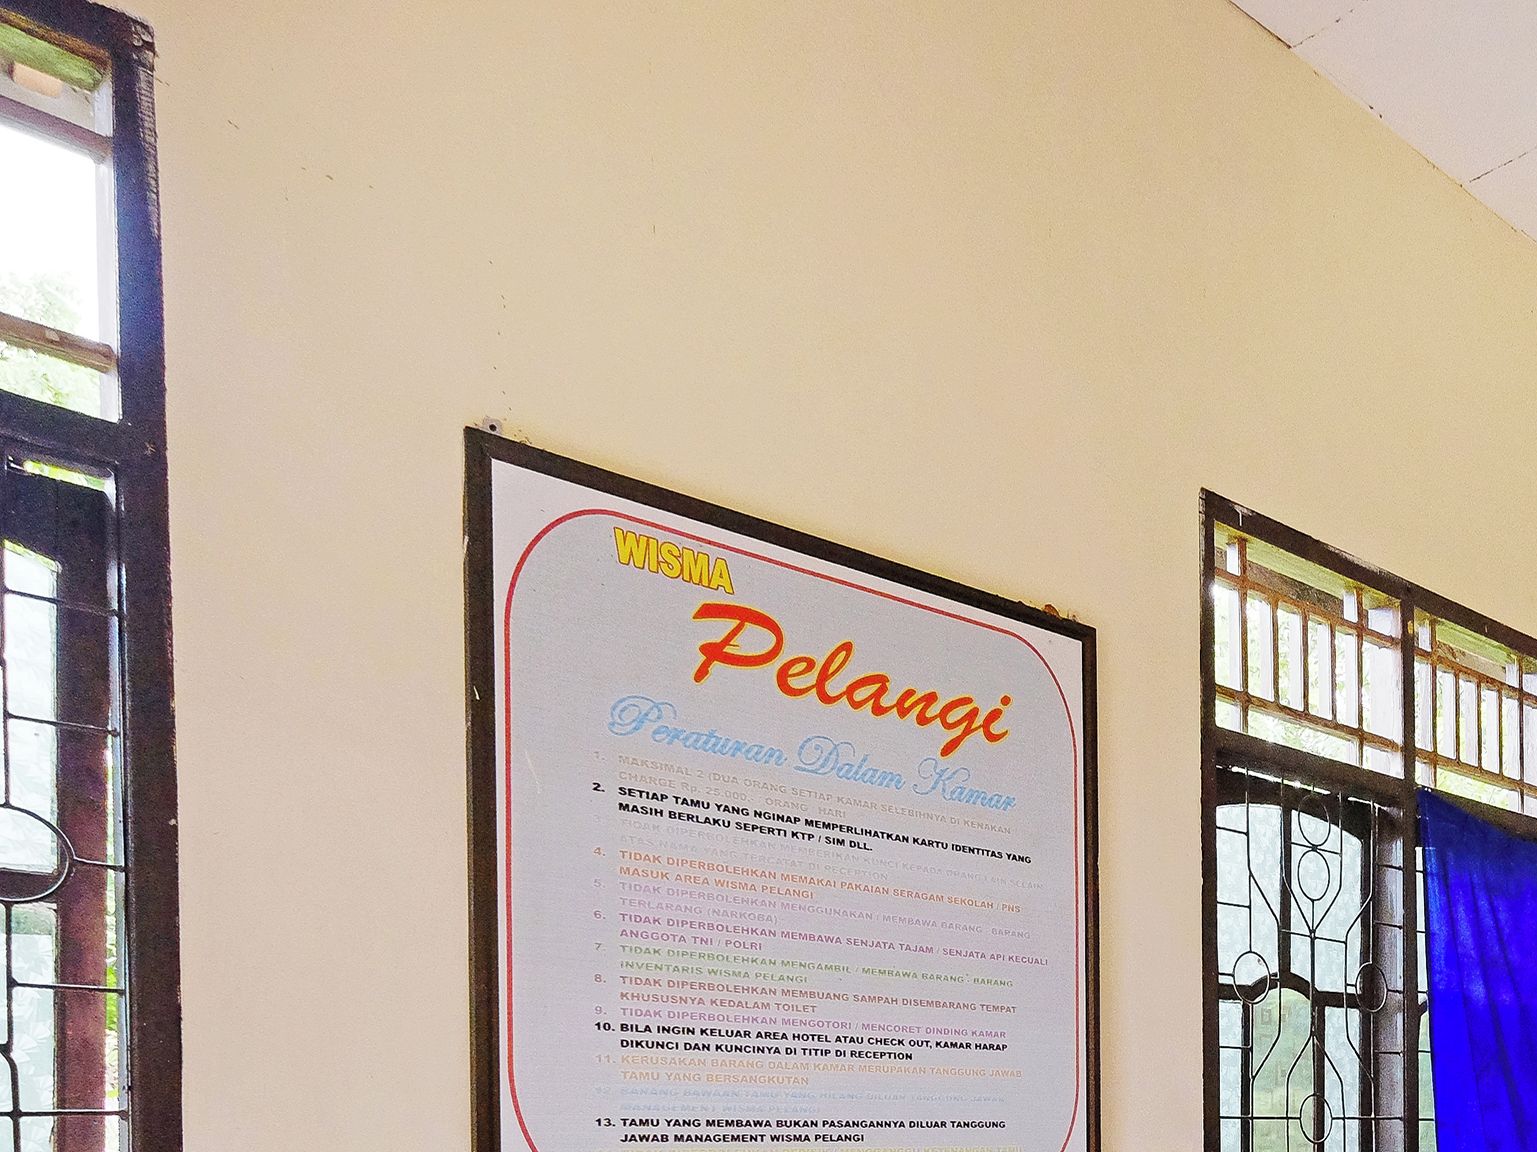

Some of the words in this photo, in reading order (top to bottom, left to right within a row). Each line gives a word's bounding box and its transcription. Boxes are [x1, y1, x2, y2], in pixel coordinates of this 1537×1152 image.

[613, 527, 735, 595] WISMA
[691, 603, 1012, 758] Pelangi
[607, 695, 788, 766] Peraturan
[792, 735, 907, 793] Dalam
[911, 757, 1018, 812] Kamar
[591, 782, 606, 794] 2.
[618, 786, 668, 804] SETIAP
[673, 795, 710, 811] TAMU
[715, 803, 749, 818] YANG
[753, 809, 801, 826] NGINAP
[804, 818, 909, 844] MEMPERLIHATKAN
[912, 836, 948, 850] KARTU
[951, 842, 1003, 859] IDENTITAS
[1005, 852, 1031, 864] YANG
[617, 802, 664, 819] MASIH
[667, 810, 731, 829] BERLAKU
[735, 821, 787, 838] SEPERTI
[790, 830, 815, 843] KTP
[824, 835, 845, 847] SIM
[848, 839, 873, 852] DLL.
[618, 849, 662, 865] TIDAK
[666, 856, 777, 880] DIPERBOLEHKAN
[780, 871, 836, 888] MEMAKAI
[839, 880, 889, 895] PAKAIAN
[892, 887, 944, 903] SERAGAM
[947, 894, 994, 909] SEKOLAH
[1001, 902, 1020, 913] PNS
[618, 865, 670, 881] MASUK
[674, 872, 710, 886] AREA
[713, 877, 757, 892] WISMA
[760, 883, 813, 899] PELANGI
[619, 912, 662, 926] TIDAK
[666, 917, 777, 938] DIPERBOLEHKAN
[780, 929, 842, 945] MEMBAWA
[845, 936, 895, 950] SENJATA
[898, 942, 934, 954] TAJAM
[942, 947, 986, 960] SENJATA
[989, 952, 1005, 962] API
[1007, 954, 1048, 966] KECUALI
[619, 928, 687, 944] ANGGOTA
[692, 935, 713, 947] TNI
[724, 938, 762, 951] POLRI
[619, 975, 662, 988] TIDAK
[666, 978, 777, 996] DIPERBOLEHKAN
[781, 987, 849, 1001] MEMBUANG
[852, 993, 898, 1005] SAMPAH
[901, 996, 976, 1011] DISEMBARANG
[979, 1002, 1017, 1014] TEMPAT
[619, 991, 705, 1006] KHUSUSNYA
[709, 997, 770, 1010] KEDALAM
[774, 1001, 817, 1013] TOILET
[593, 1021, 616, 1032] 10.
[619, 1022, 652, 1034] BILA
[656, 1024, 695, 1036] INGIN
[699, 1026, 751, 1039] KELUAR
[755, 1029, 788, 1040] AREA
[792, 1031, 828, 1042] HOTEL
[834, 1034, 864, 1044] ATAU
[866, 1035, 905, 1046] CHECK
[908, 1037, 933, 1049] OUT,
[934, 1039, 971, 1049] KAMAR
[974, 1041, 1007, 1051] HARAP
[621, 1006, 663, 1019] TIDAK
[667, 1009, 777, 1025] DIPERBOLEHKAN
[780, 1016, 853, 1030] MENGOTORI
[861, 1021, 922, 1034] MENCORET
[925, 1025, 967, 1036] DINDING
[970, 1028, 1006, 1038] KAMAR
[619, 1038, 679, 1050] DIKUNCI
[683, 1041, 711, 1052] DAN
[714, 1042, 781, 1055] KUNCINYA
[784, 1045, 797, 1055] DI
[801, 1046, 831, 1057] TITIP
[834, 1048, 846, 1057] DI
[849, 1048, 913, 1060] RECEPTION
[595, 1117, 617, 1127] 13.
[621, 1117, 660, 1127] TAMU
[665, 1117, 701, 1127] YANG
[705, 1117, 772, 1127] MEMBAWA
[775, 1118, 818, 1127] BUKAN
[821, 1118, 905, 1128] PASANGANNYA
[908, 1119, 947, 1128] DILUAR
[950, 1119, 1005, 1128] TANGGUNG
[620, 1133, 669, 1143] JAWAB
[673, 1133, 766, 1142] MANAGEMENT
[769, 1132, 810, 1142] WISMA
[814, 1132, 864, 1142] PELANGI
